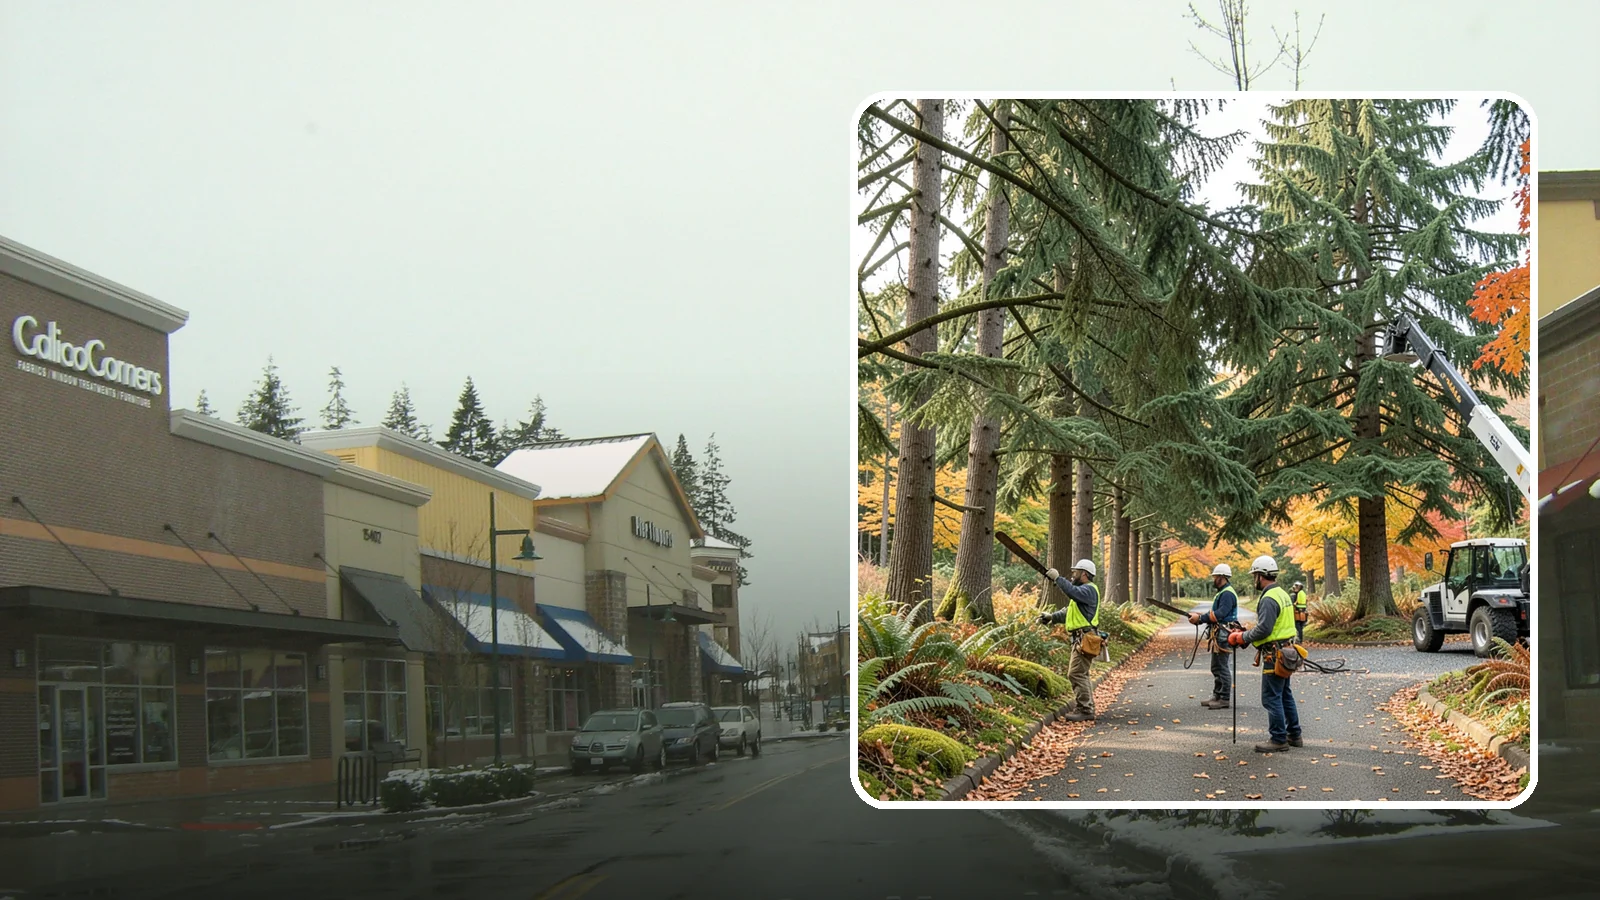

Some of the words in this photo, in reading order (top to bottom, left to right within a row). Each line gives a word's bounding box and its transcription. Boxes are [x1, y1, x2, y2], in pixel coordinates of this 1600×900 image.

[13, 315, 162, 395] CalicoCorners
[16, 360, 47, 377] FABRICS
[51, 370, 78, 387] WINDOW
[78, 378, 117, 399] TREATMENTS
[119, 391, 151, 409] FURNITURE
